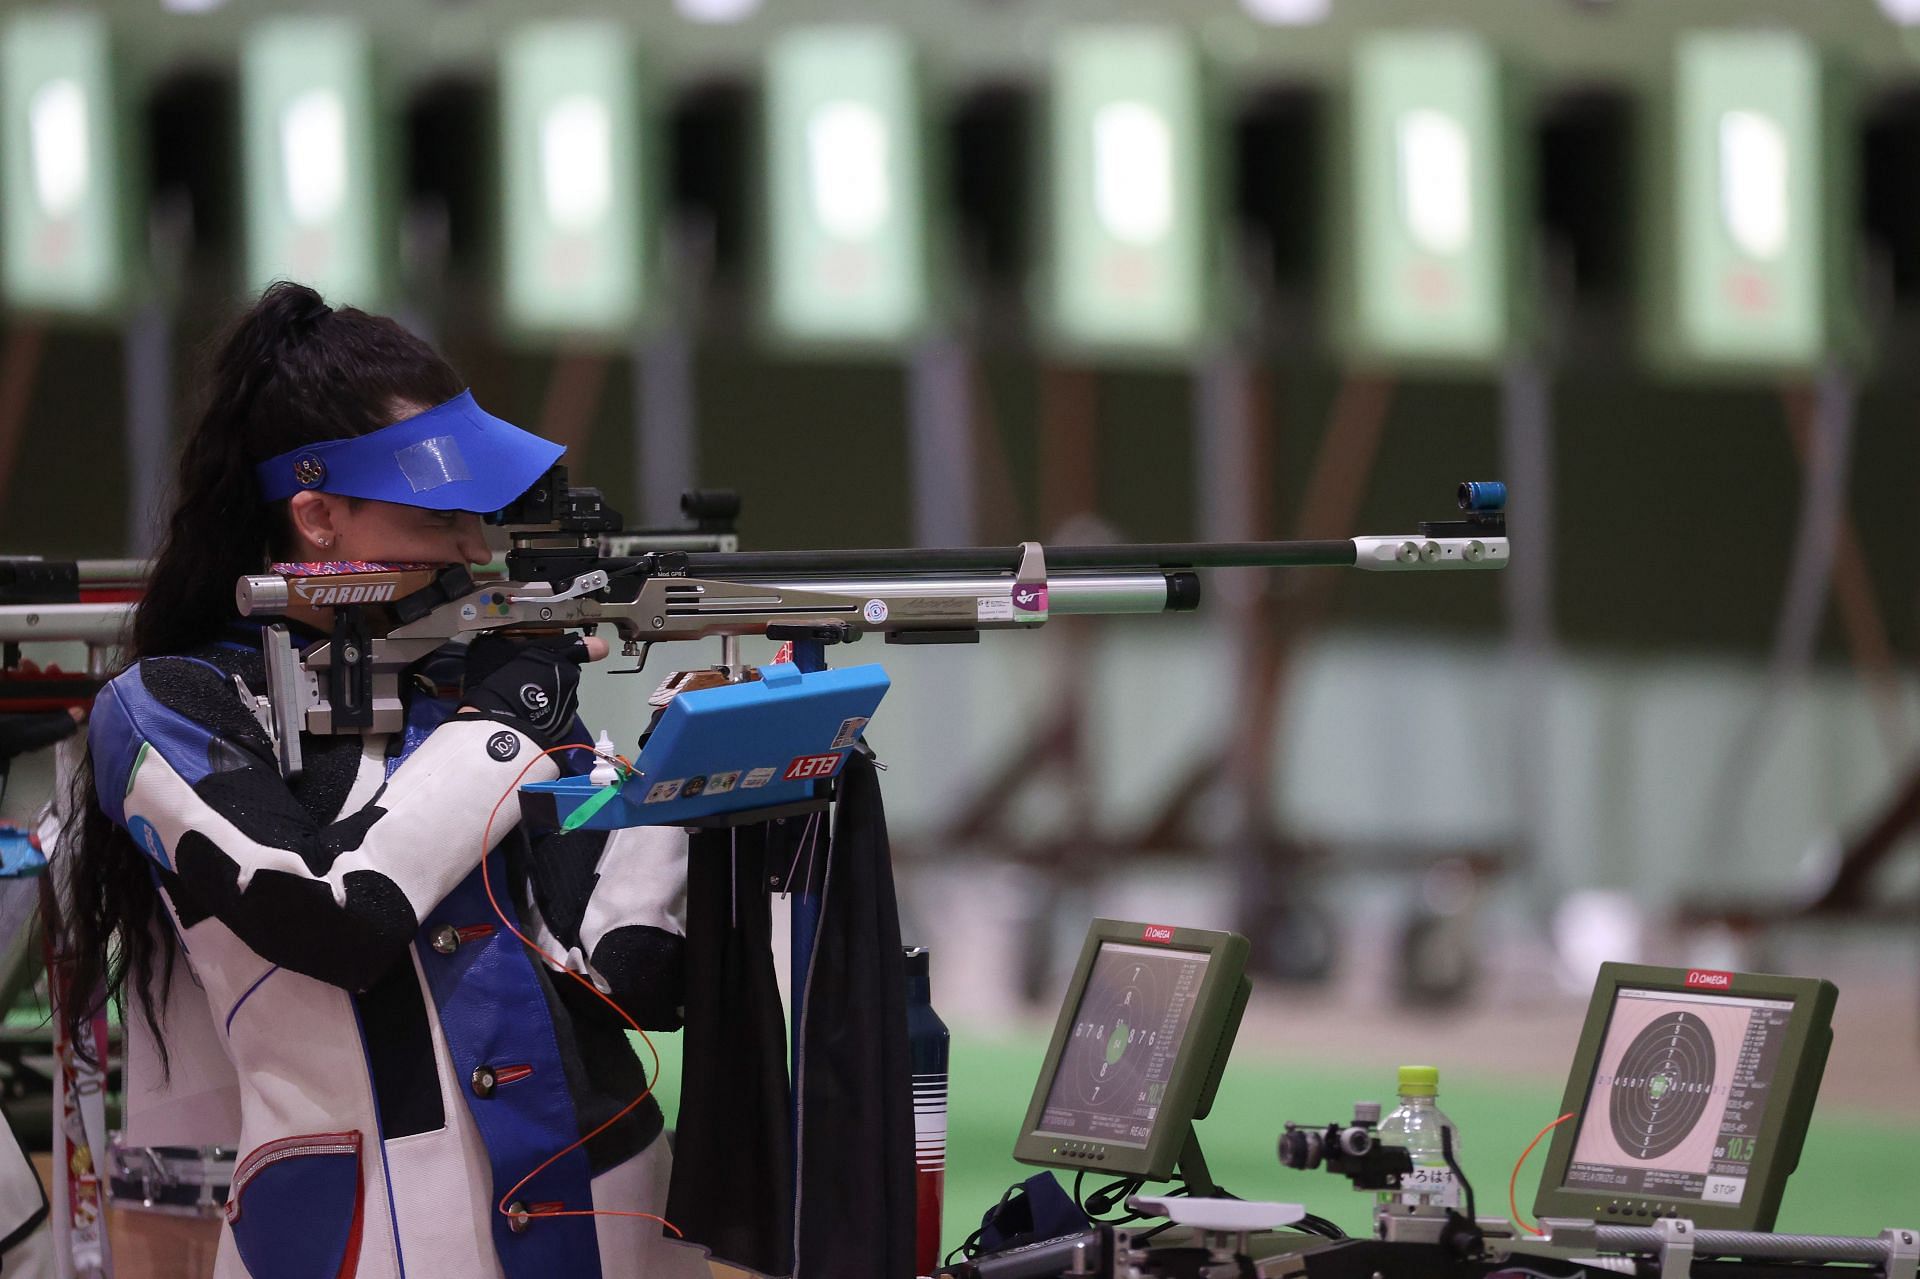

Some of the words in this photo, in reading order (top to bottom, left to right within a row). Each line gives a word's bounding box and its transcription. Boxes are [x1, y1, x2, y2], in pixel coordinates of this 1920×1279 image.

[310, 584, 397, 605] PARDINI
[494, 734, 515, 754] 10.9
[787, 756, 839, 778] ELEY
[1152, 930, 1171, 939] OMEGA
[1132, 968, 1140, 981] 7
[1699, 975, 1728, 985] OMEGA
[1124, 992, 1132, 1005] 8
[1678, 1013, 1684, 1022] 4
[1076, 1023, 1083, 1037] 6
[1086, 1024, 1093, 1037] 7
[1096, 1025, 1104, 1039] 8
[1128, 1029, 1135, 1043] 8
[1138, 1030, 1147, 1045] 7
[1149, 1031, 1156, 1046] 6
[1100, 1062, 1107, 1077] 8
[1614, 1077, 1620, 1086] 4
[1638, 1079, 1644, 1088] 7
[1680, 1082, 1686, 1092] 7
[1705, 1085, 1711, 1093] 4
[1092, 1087, 1100, 1101] 7
[1650, 1112, 1657, 1121] 7
[1130, 1126, 1150, 1137] READY
[1643, 1136, 1649, 1145] 5
[1727, 1137, 1755, 1160] 10.5
[1712, 1183, 1737, 1195] STOP
